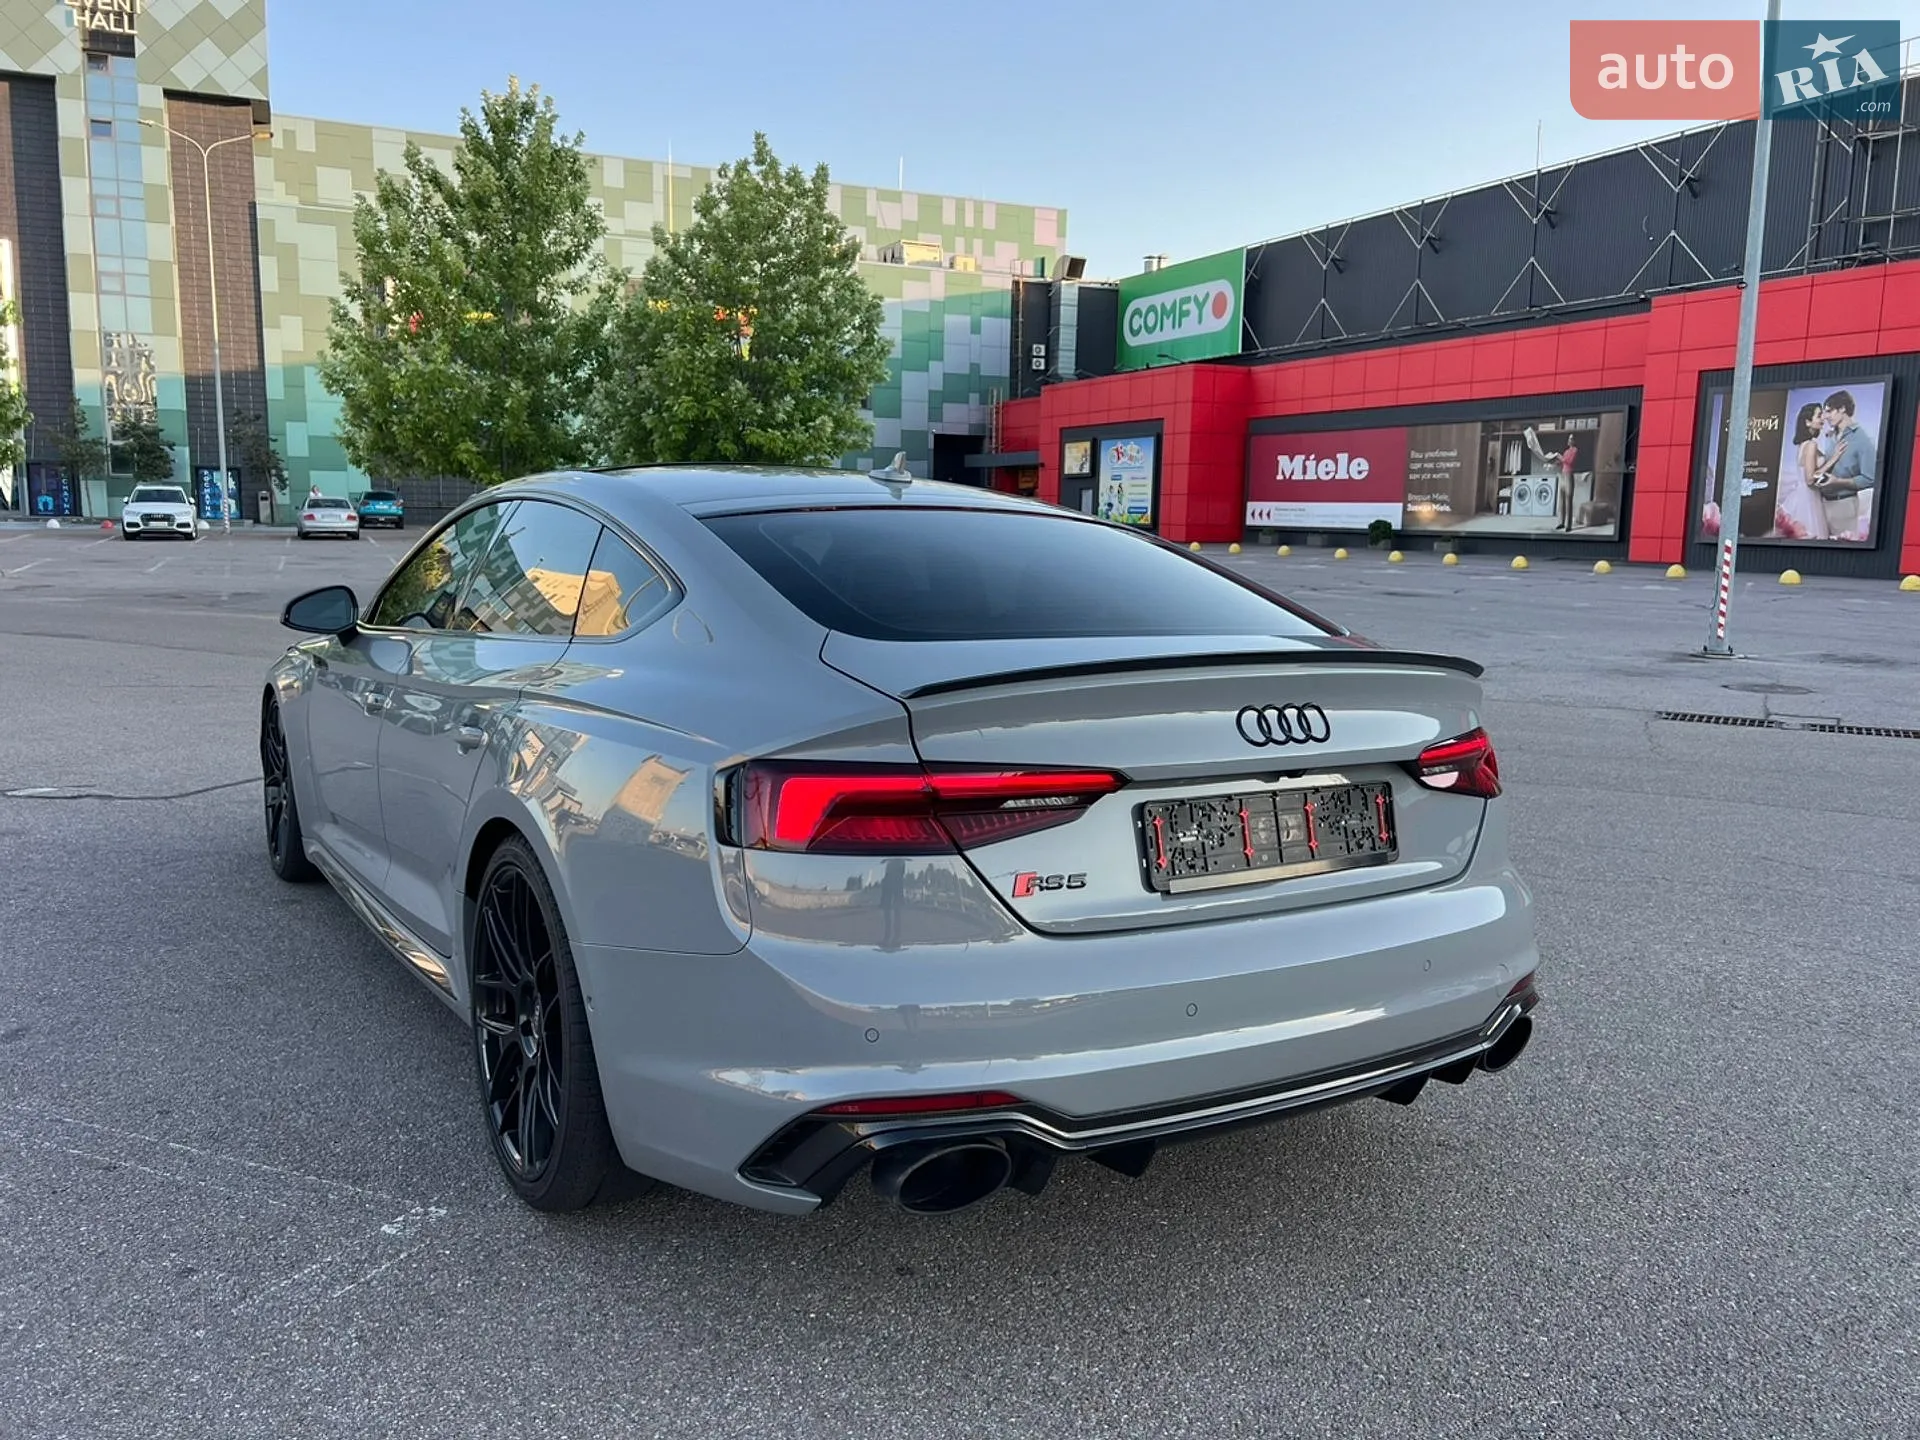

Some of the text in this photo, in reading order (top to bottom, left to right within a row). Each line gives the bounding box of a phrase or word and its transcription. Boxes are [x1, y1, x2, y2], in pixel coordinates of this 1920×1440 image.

[73, 9, 138, 34] HALL
[1128, 291, 1210, 337] COMFY
[1276, 452, 1370, 480] Miele
[1022, 872, 1087, 893] RS5
